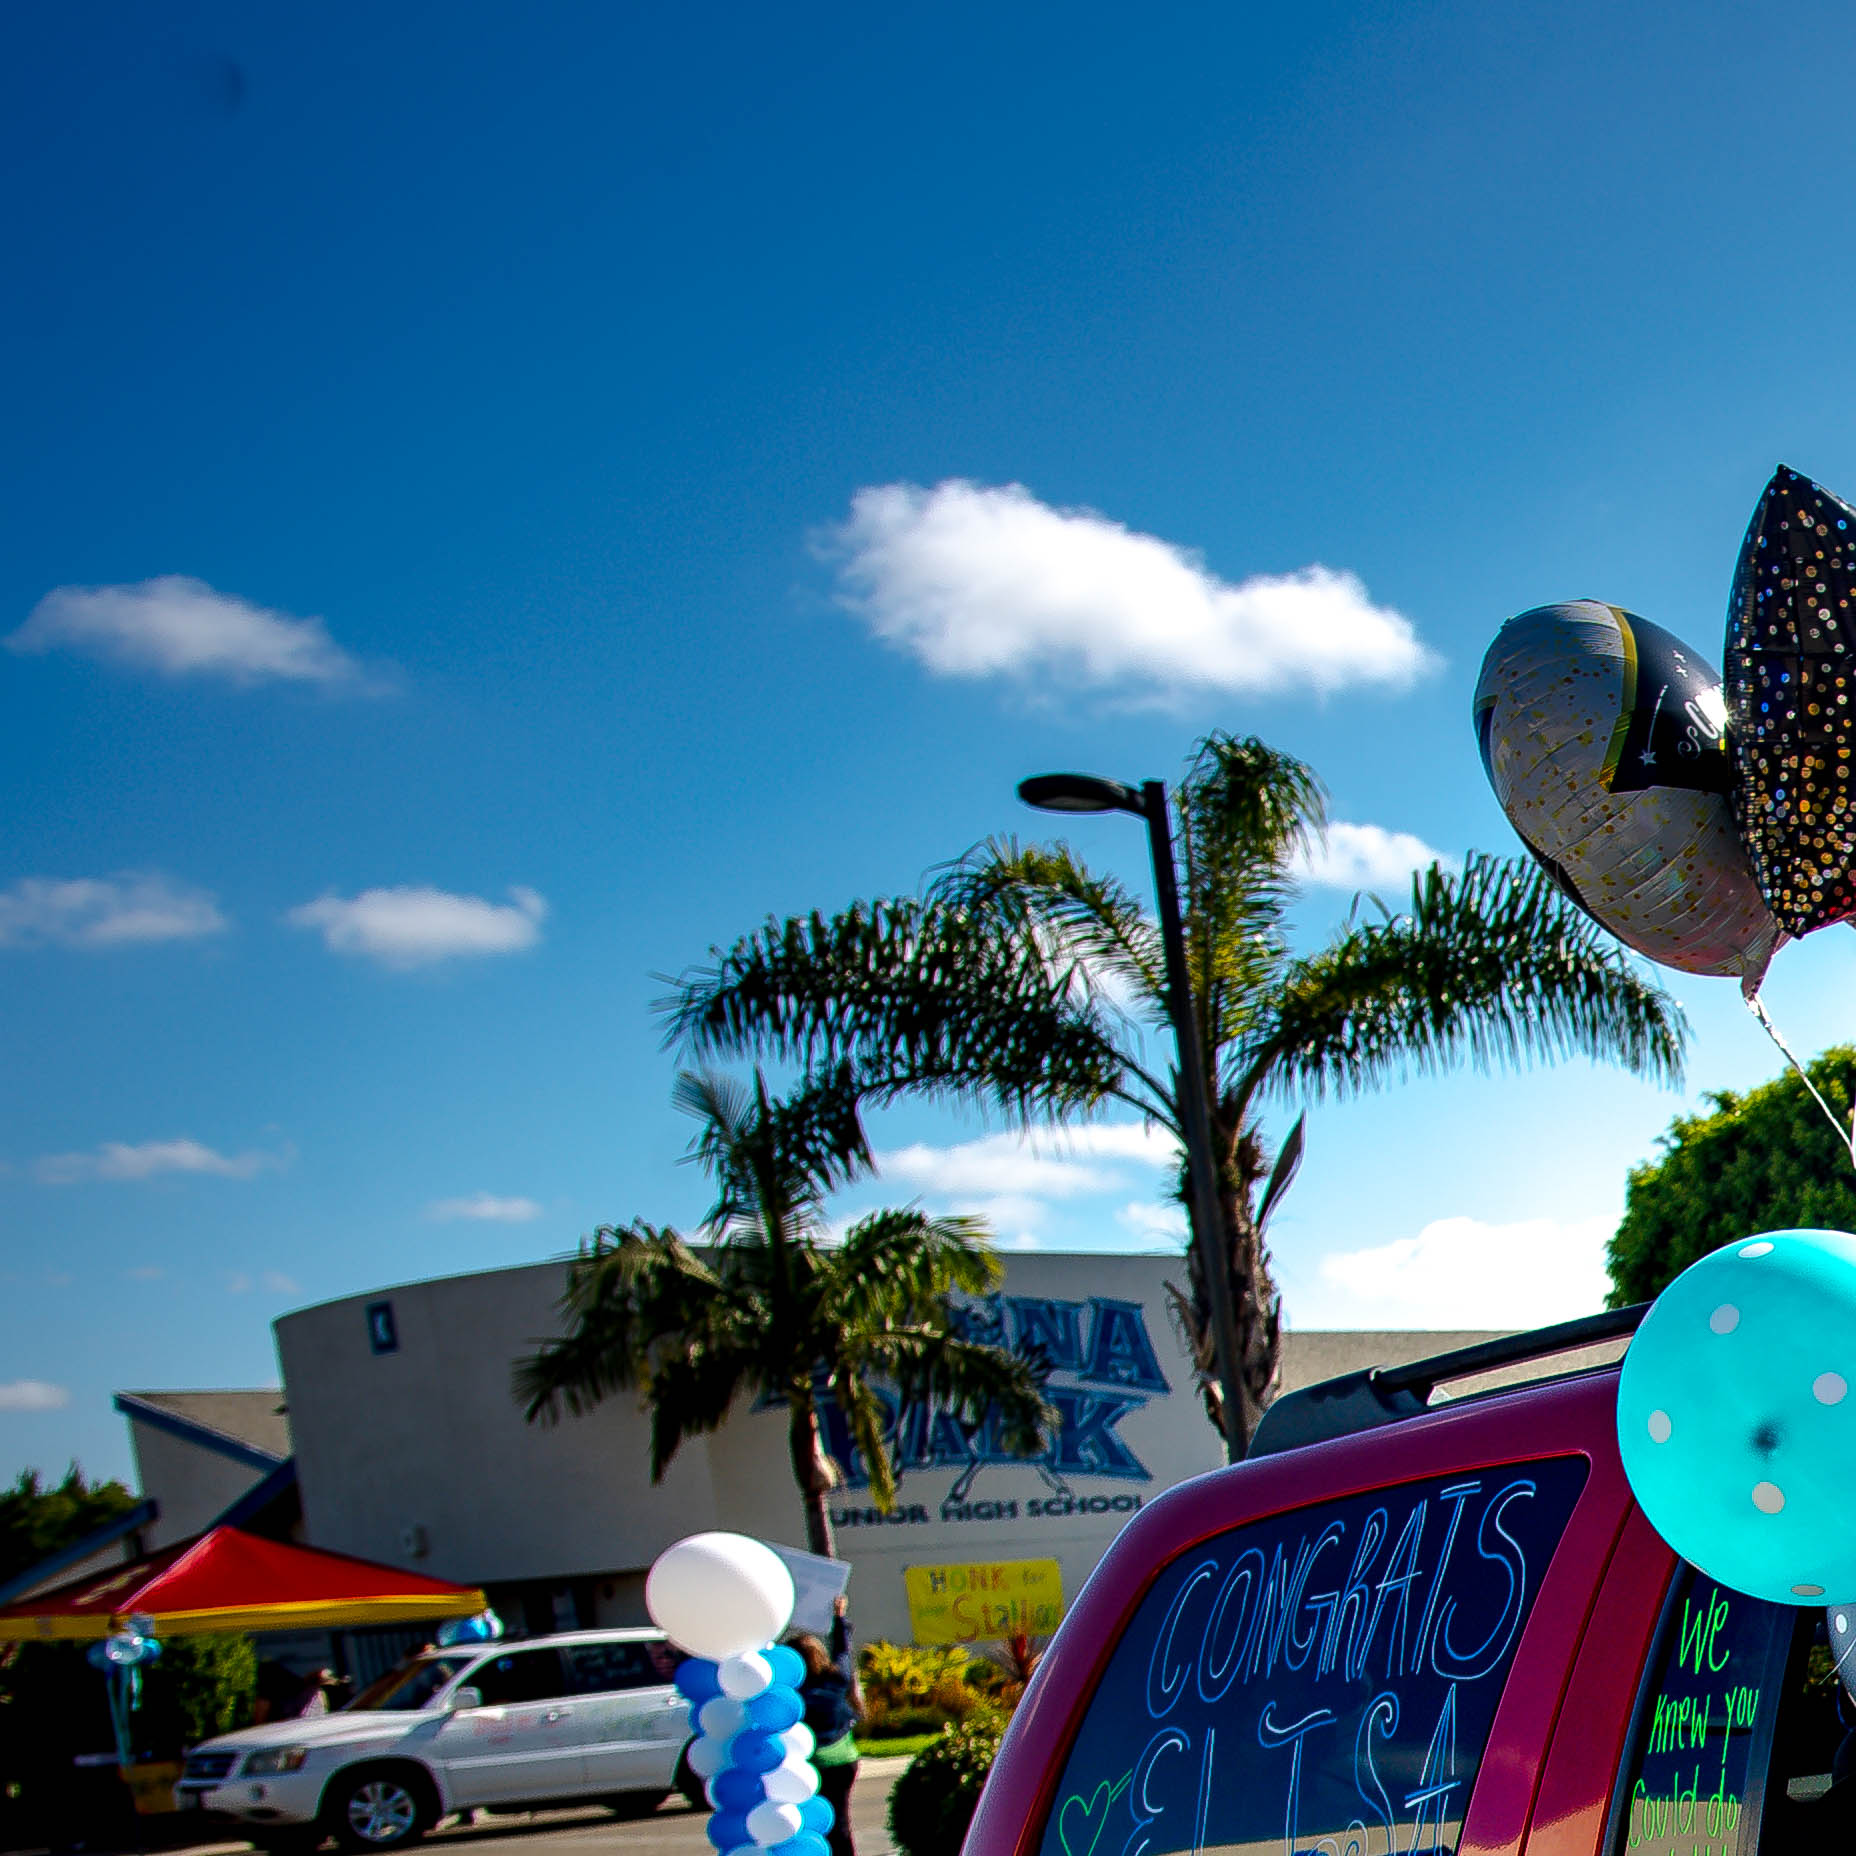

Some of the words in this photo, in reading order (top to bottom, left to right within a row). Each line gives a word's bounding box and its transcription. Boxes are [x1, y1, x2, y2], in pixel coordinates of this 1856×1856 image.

[831, 1503, 929, 1527] UNIOR
[940, 1500, 1018, 1523] HIGH
[929, 1566, 1010, 1592] HONK
[1146, 1481, 1536, 1719] CONGRATS
[1724, 1686, 1760, 1765] you
[1707, 1767, 1738, 1839] do
